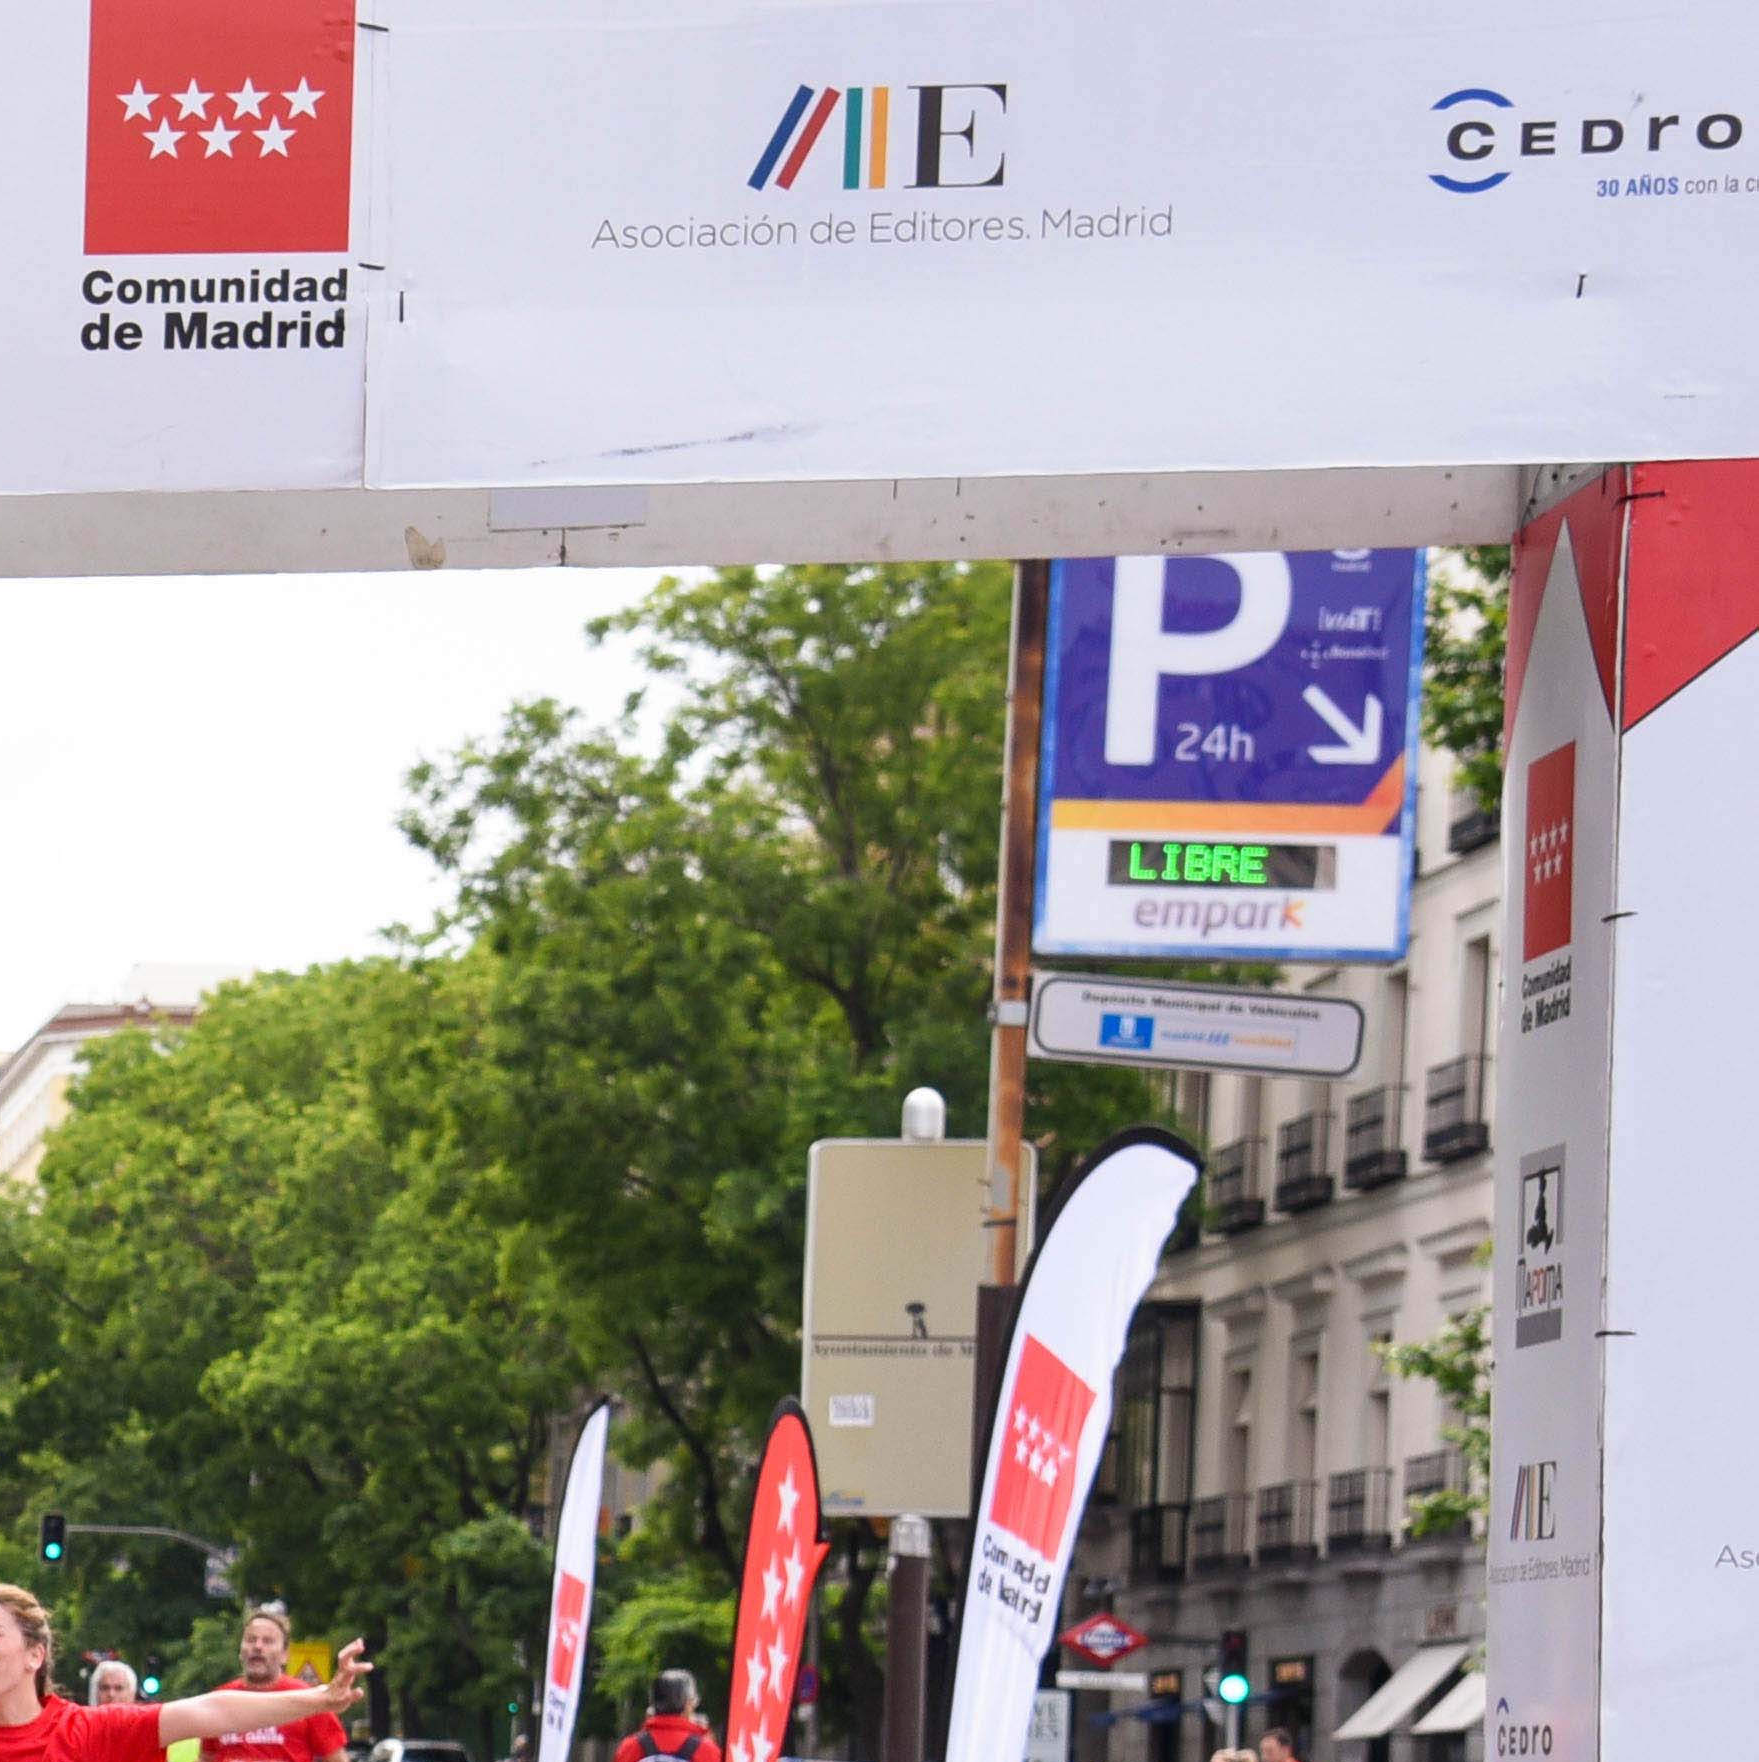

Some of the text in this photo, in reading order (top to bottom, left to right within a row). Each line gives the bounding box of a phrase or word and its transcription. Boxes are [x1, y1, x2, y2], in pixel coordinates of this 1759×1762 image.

[1597, 174, 1739, 197] 30 AÑOS con la
[591, 212, 798, 250] Asociación
[808, 213, 856, 247] de
[1041, 205, 1173, 240] Madrid
[82, 268, 348, 306] Comunidad
[80, 310, 346, 351] de Madrid
[1105, 549, 1294, 767] P
[1174, 720, 1255, 763] 24h
[1129, 841, 1268, 885] LIBRE
[1133, 891, 1304, 939] empark
[1522, 954, 1572, 999] Comunidad
[1522, 987, 1570, 1033] de Madrid
